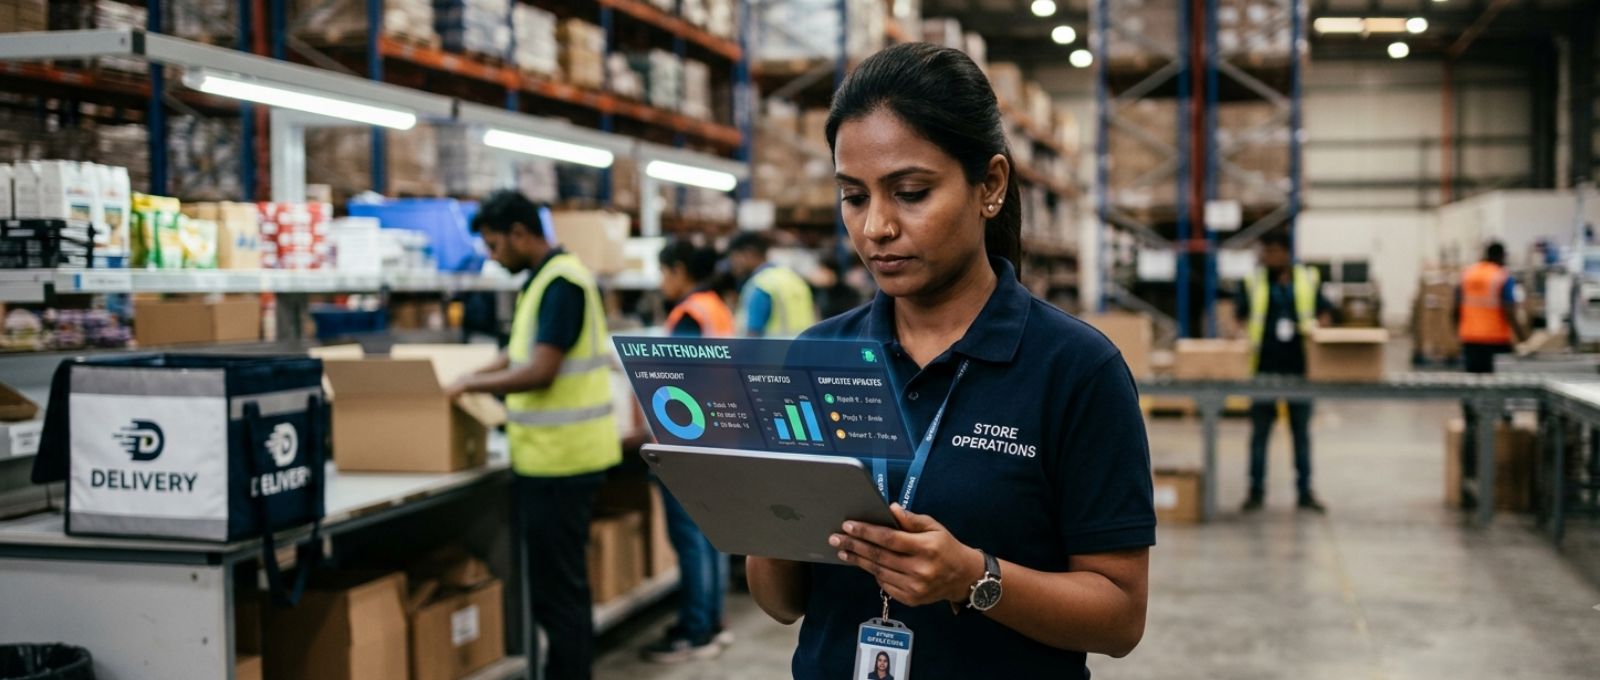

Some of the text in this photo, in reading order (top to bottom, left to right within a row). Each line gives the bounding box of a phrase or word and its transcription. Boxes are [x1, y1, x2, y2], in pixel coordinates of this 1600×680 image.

[621, 343, 732, 359] LIVE ATTENDANCE
[973, 423, 1019, 439] STORE
[952, 435, 1037, 458] OPERATIONS
[91, 468, 199, 493] DELIVERY
